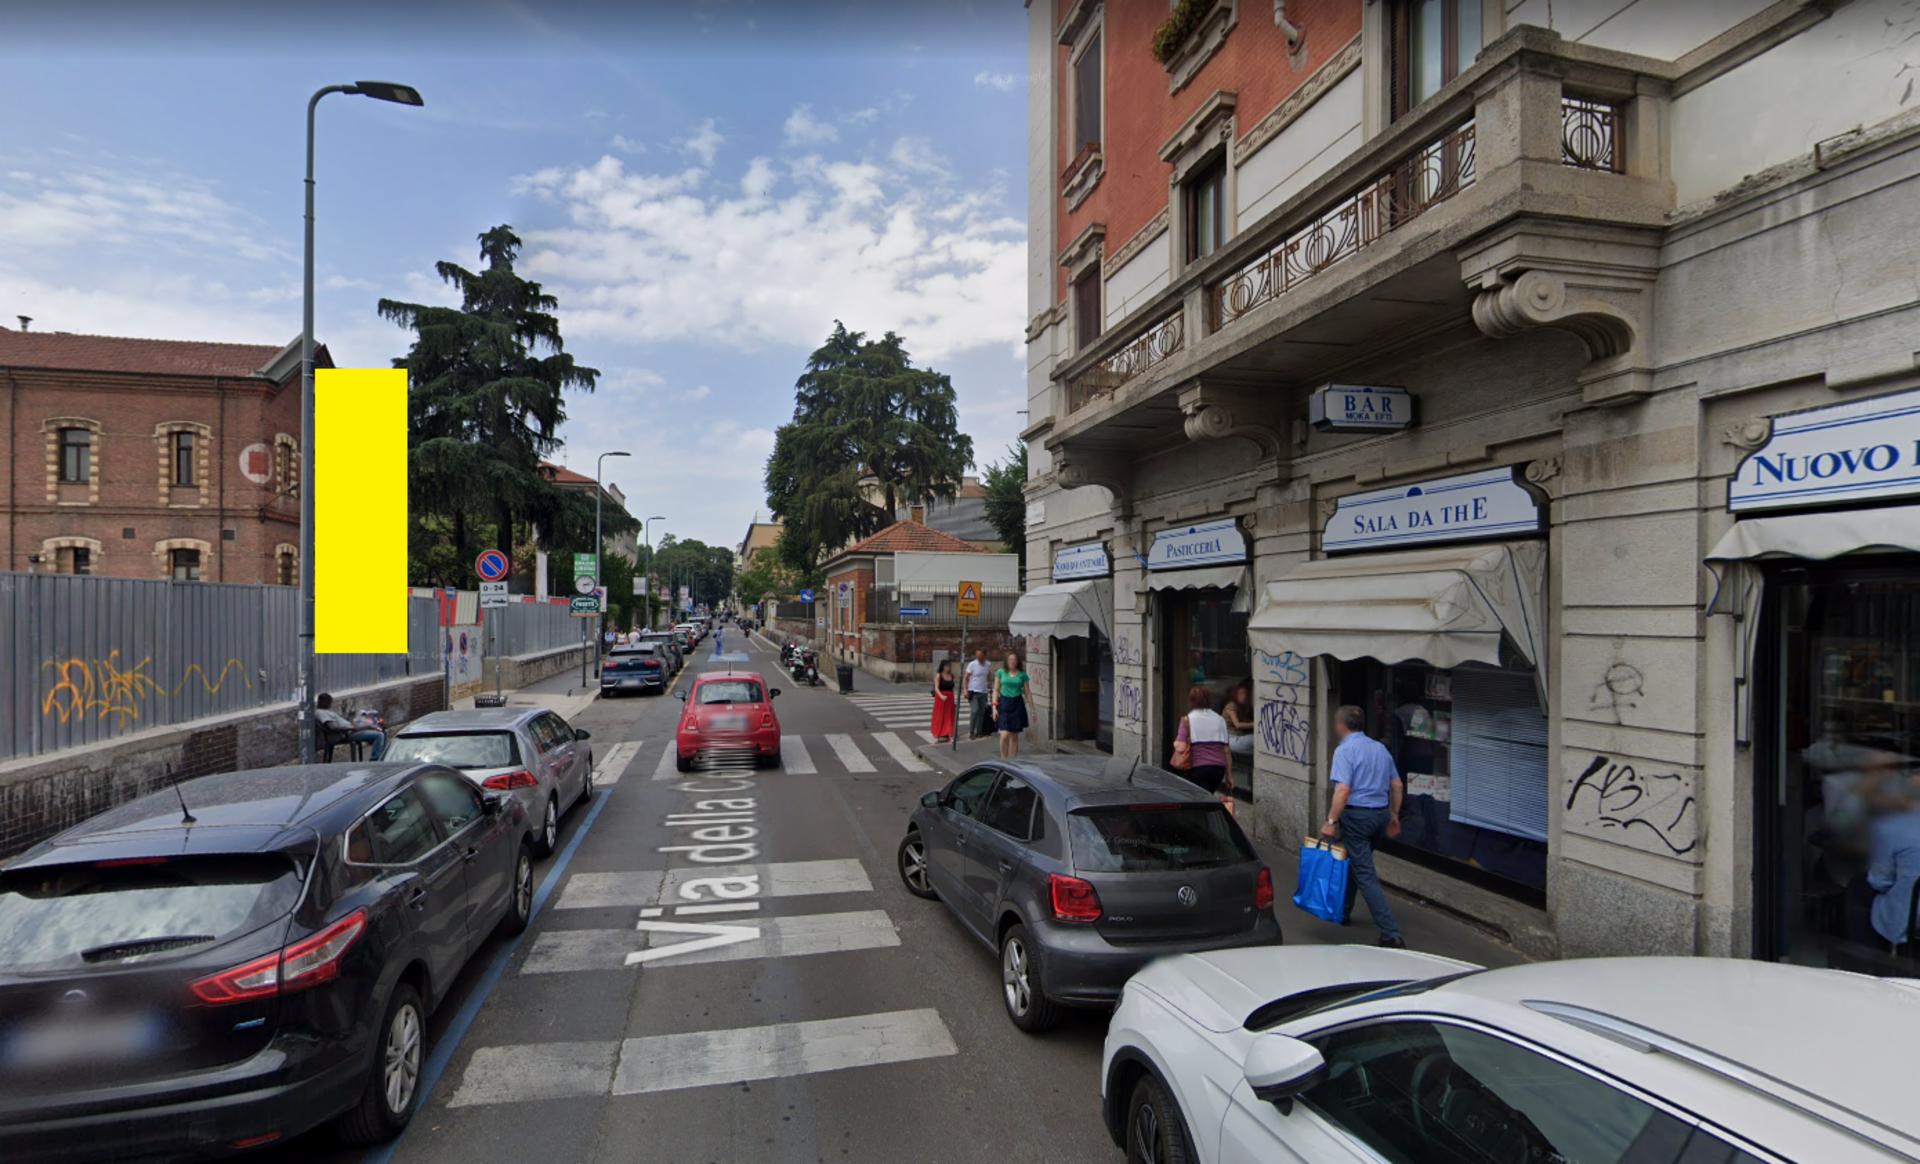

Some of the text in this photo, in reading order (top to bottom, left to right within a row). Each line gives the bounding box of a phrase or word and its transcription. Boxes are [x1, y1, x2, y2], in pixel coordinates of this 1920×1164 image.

[1344, 395, 1392, 412] BAR
[1752, 444, 1899, 486] NUOVO
[1353, 496, 1488, 534] SALA DA THE
[1166, 538, 1222, 558] PASTICCERIA
